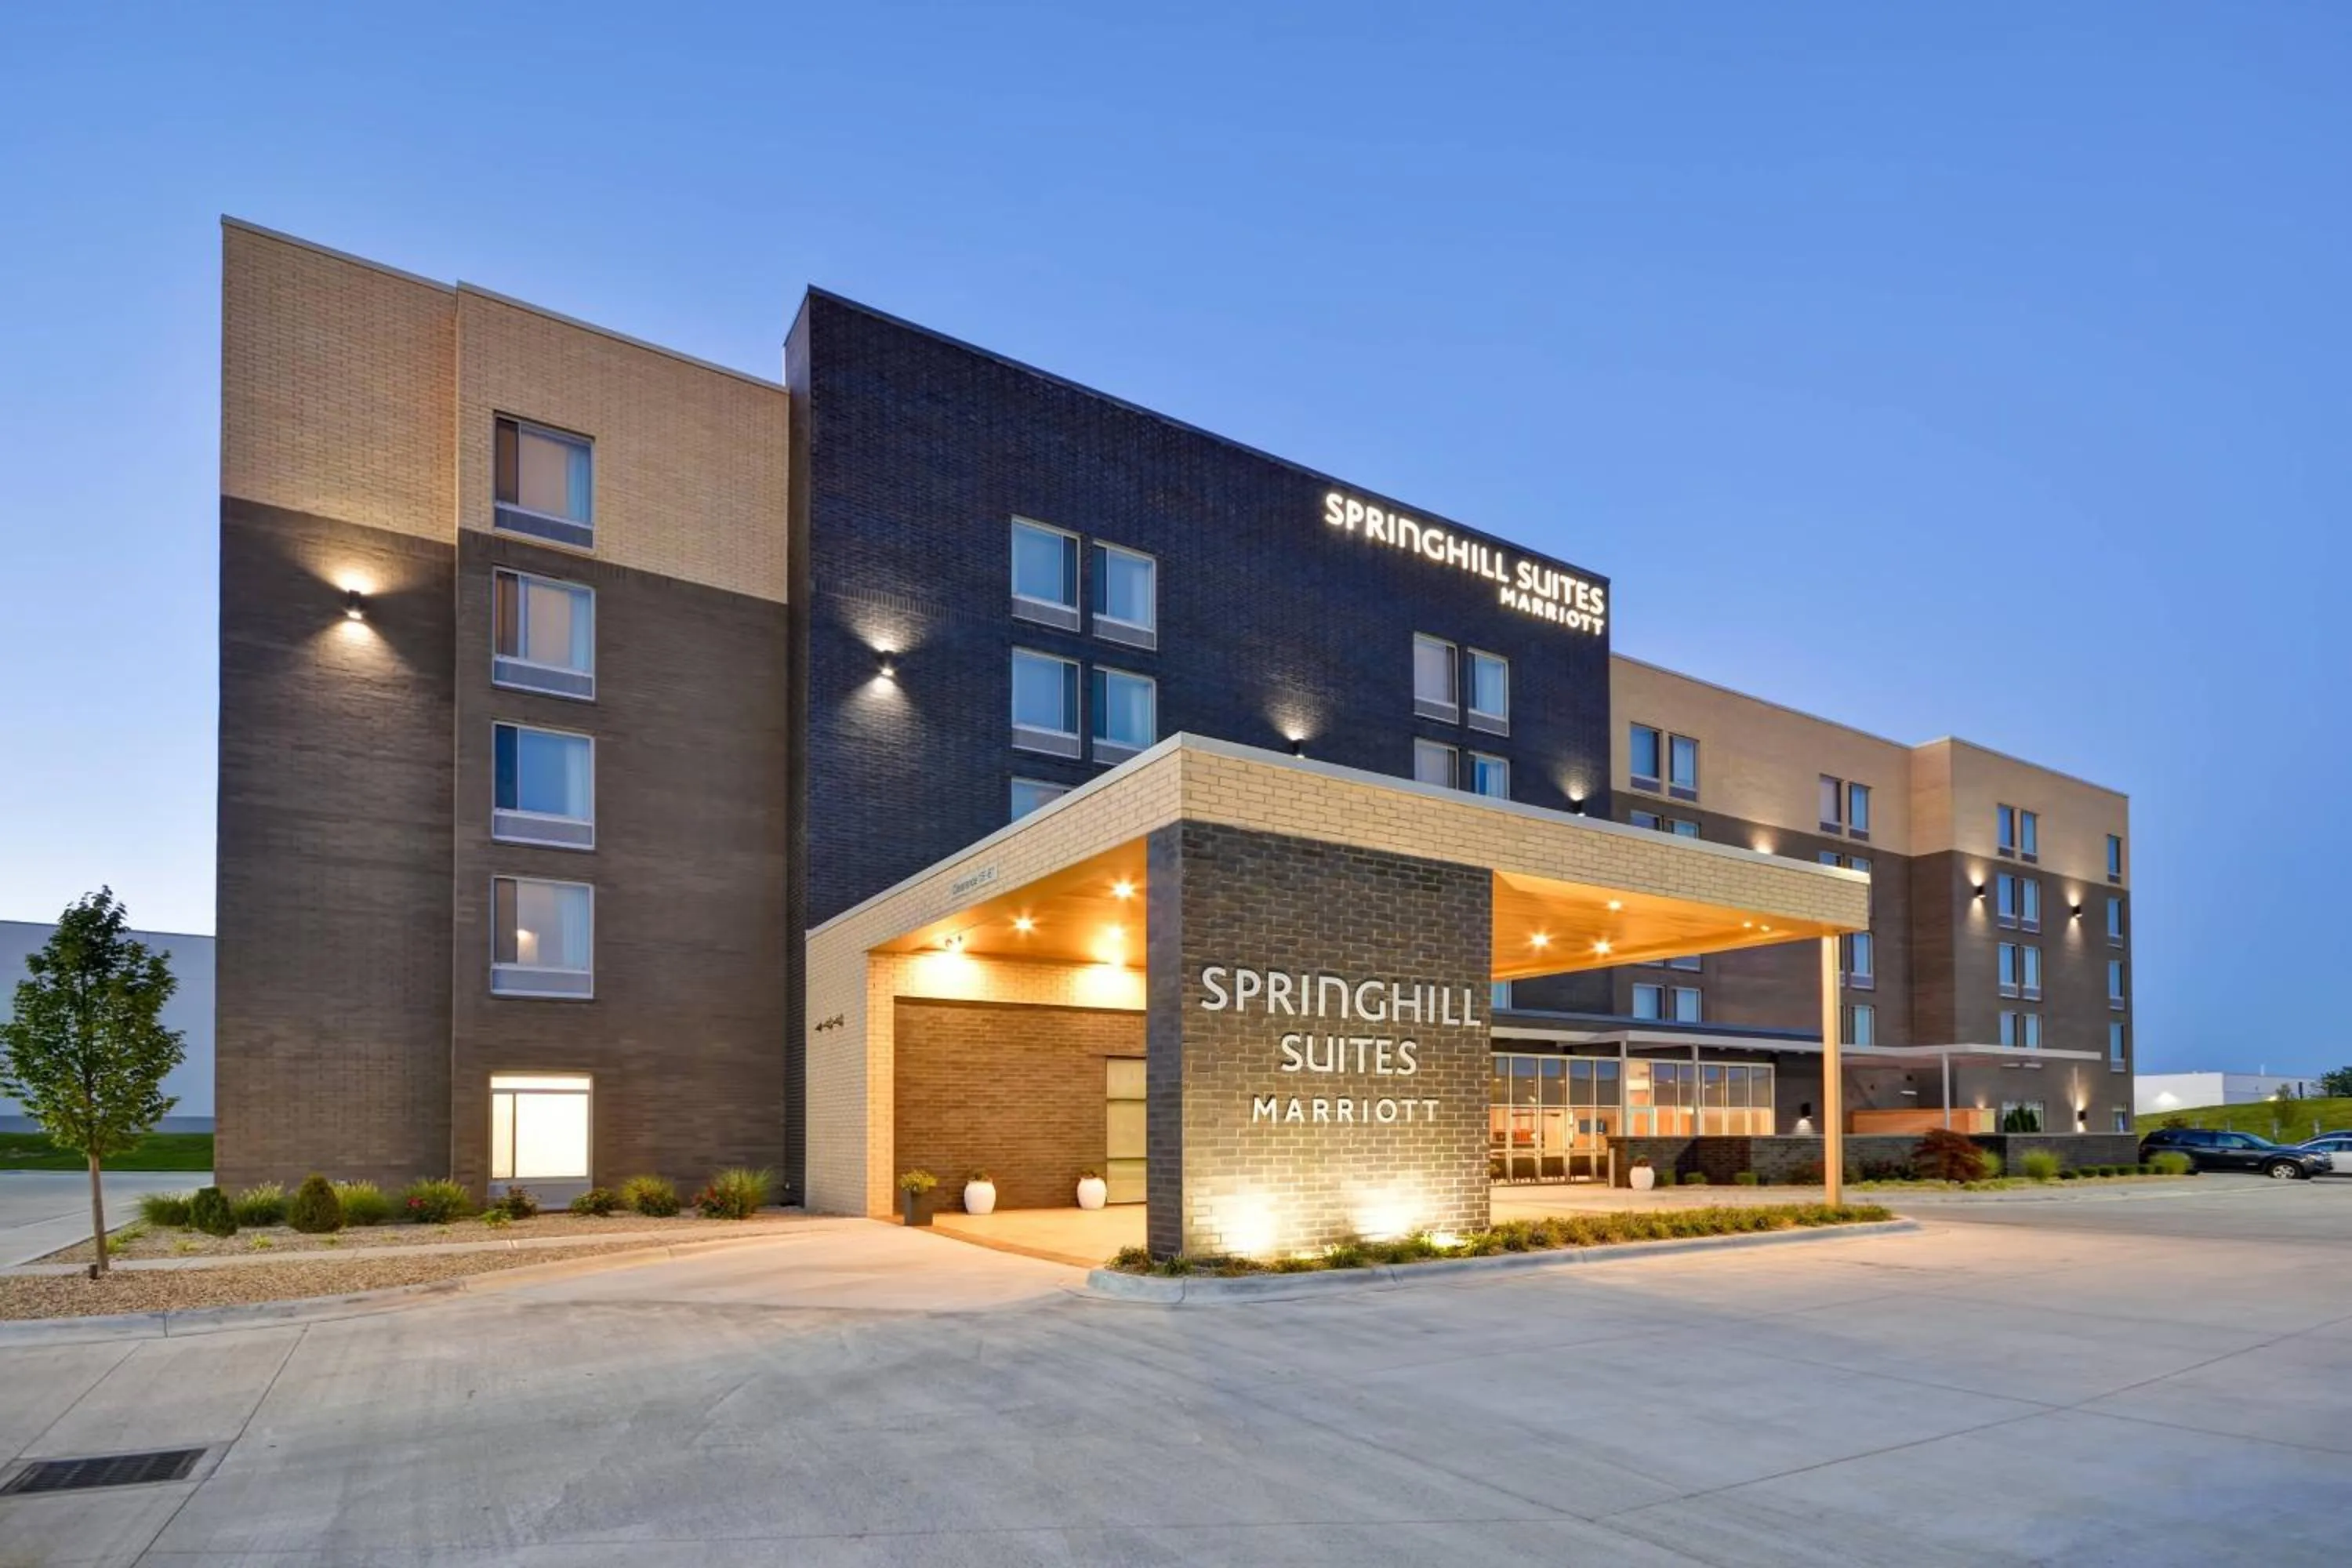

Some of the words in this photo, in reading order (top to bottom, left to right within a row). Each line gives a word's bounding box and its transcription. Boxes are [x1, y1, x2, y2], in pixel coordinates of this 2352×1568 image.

[1323, 492, 1509, 583] SPRINGHILL
[1515, 560, 1606, 616] SUITES
[1499, 586, 1605, 637] MARRIOTT
[1200, 966, 1482, 1026] SPRINGHILL
[1280, 1033, 1417, 1075] SUITES
[1252, 1097, 1440, 1123] MARRIOTT
